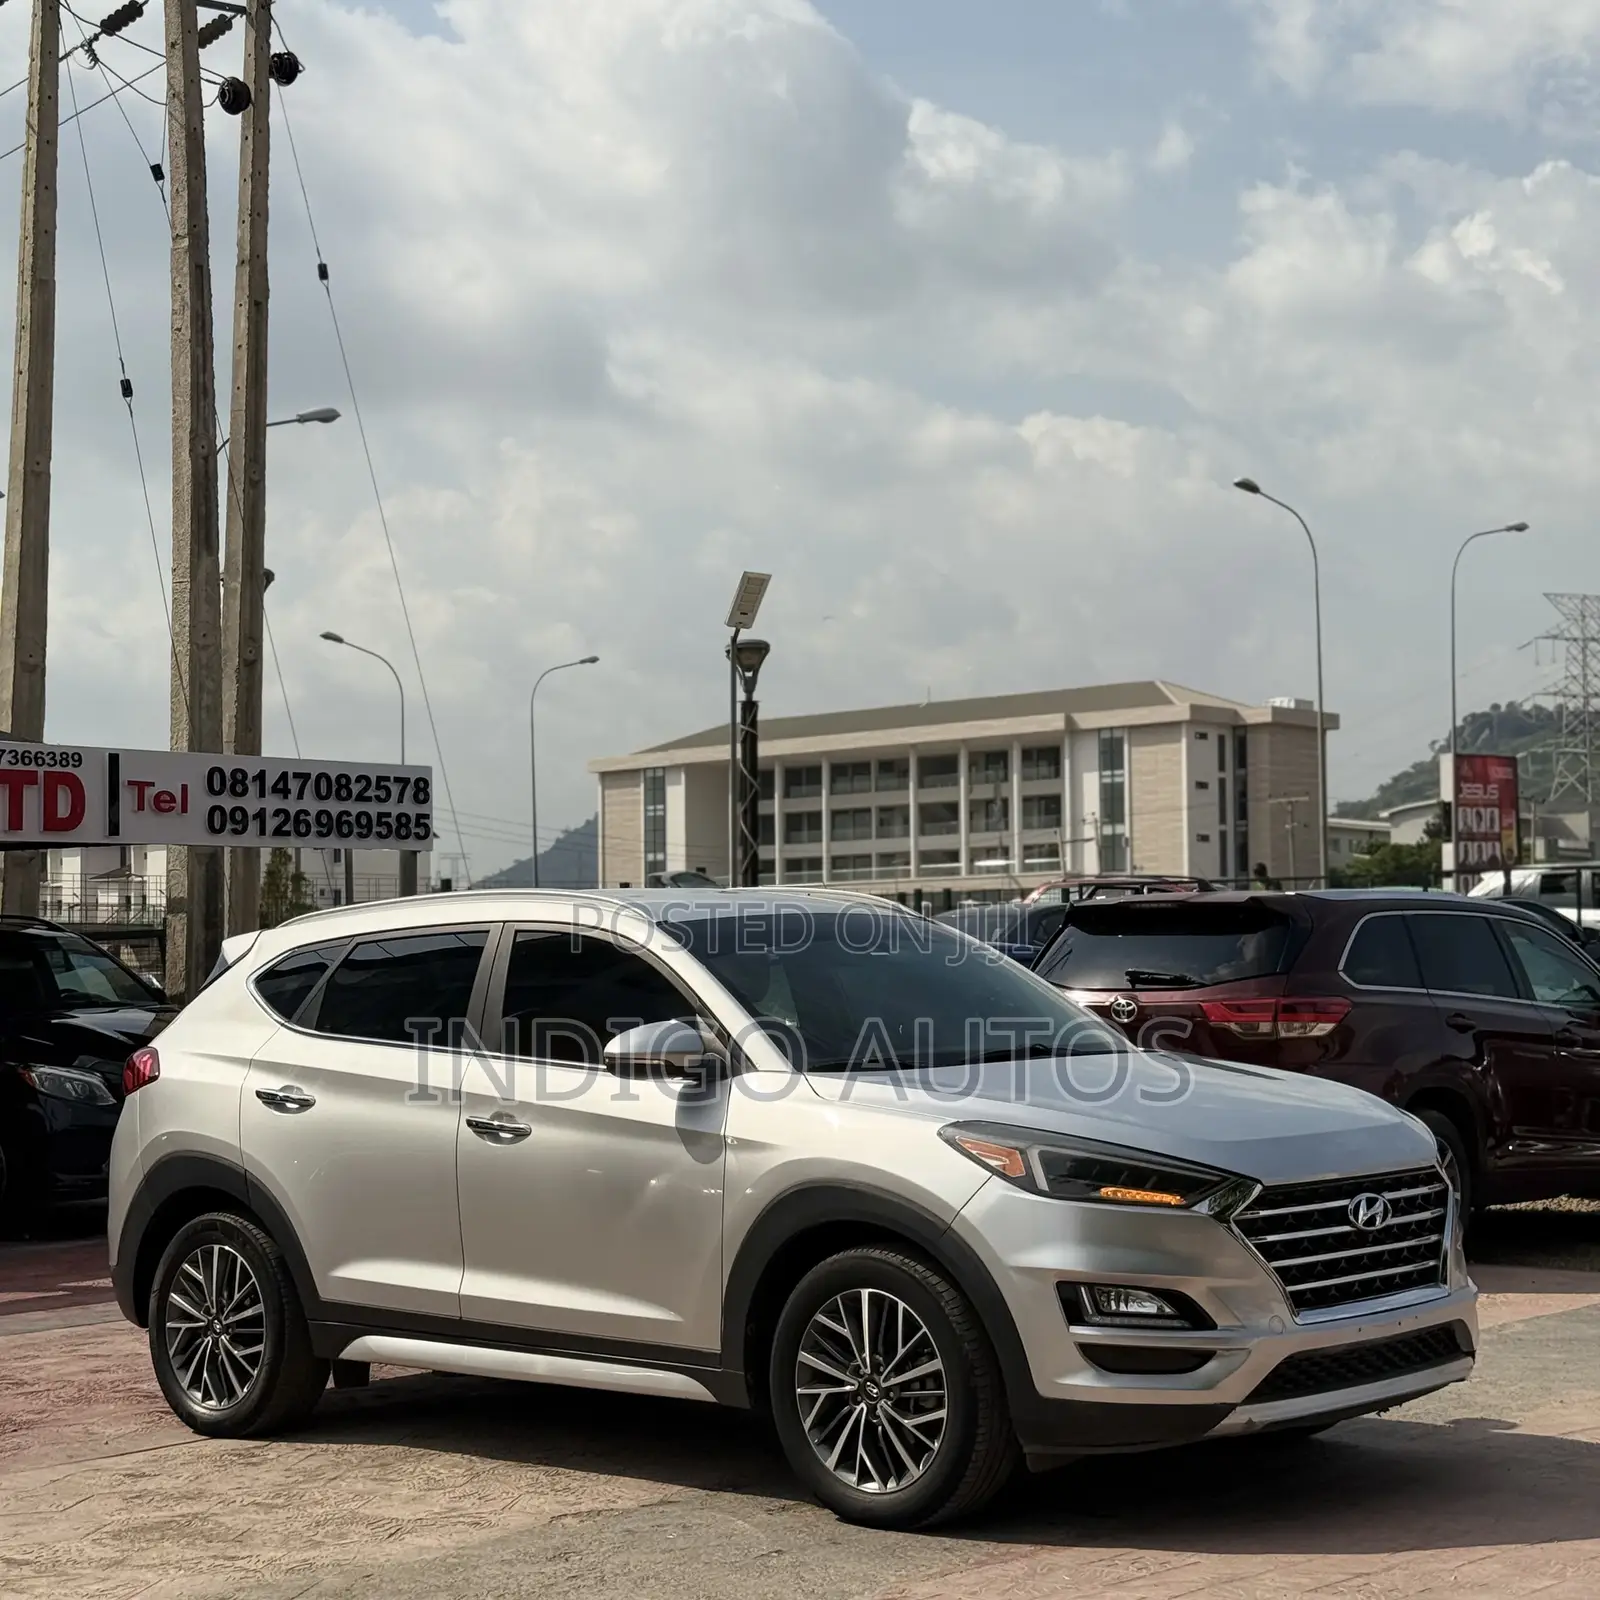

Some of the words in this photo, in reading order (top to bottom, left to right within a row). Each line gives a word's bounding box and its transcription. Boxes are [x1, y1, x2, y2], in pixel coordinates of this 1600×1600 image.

[127, 780, 188, 814] Tel
[206, 766, 431, 805] 08147082578
[206, 804, 431, 841] 09126969585
